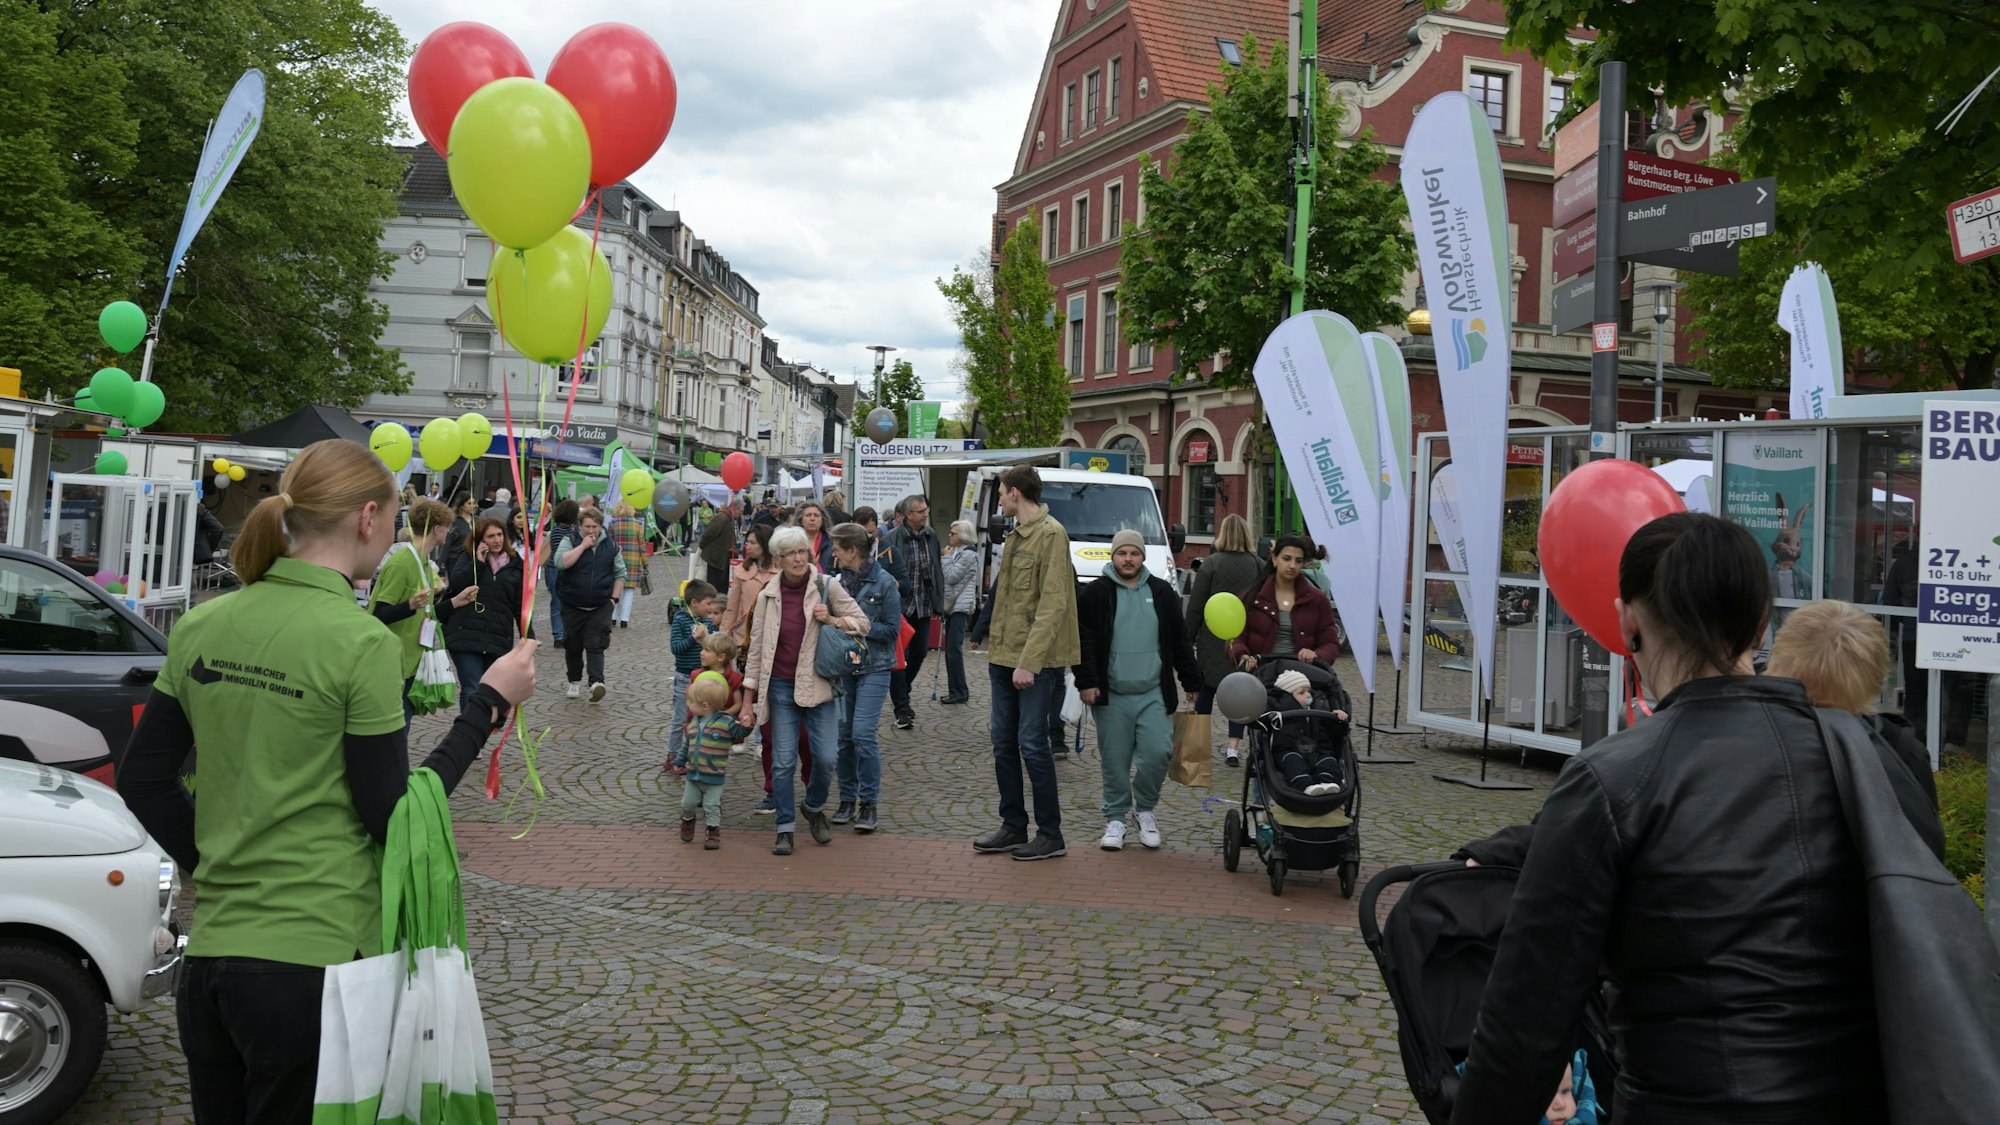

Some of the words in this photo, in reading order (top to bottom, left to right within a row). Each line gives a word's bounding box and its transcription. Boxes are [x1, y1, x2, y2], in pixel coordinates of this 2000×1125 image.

[1628, 160, 1672, 177] Bürgerhaus
[1673, 169, 1693, 183] Berg.
[1694, 173, 1714, 186] Löwe
[1627, 175, 1683, 194] Kunstmuseum
[1627, 204, 1667, 221] Bahnhof
[1954, 199, 1993, 222] H350
[549, 424, 574, 440] Quo
[577, 426, 607, 440] Vadis
[1763, 446, 1803, 459] Vaillant
[1728, 491, 1769, 502] Herzlich
[1727, 504, 1789, 516] Willkommen
[1744, 518, 1787, 529] Vaillant!
[1928, 548, 1968, 568] 27.
[1976, 555, 1991, 568] +
[1928, 569, 1964, 580] 10-18
[1968, 571, 1992, 582] Uhr
[1934, 586, 1998, 612] Berg.
[1963, 632, 2000, 644] www.
[1932, 650, 1964, 659] BELKAW
[211, 659, 242, 672] MONIKA
